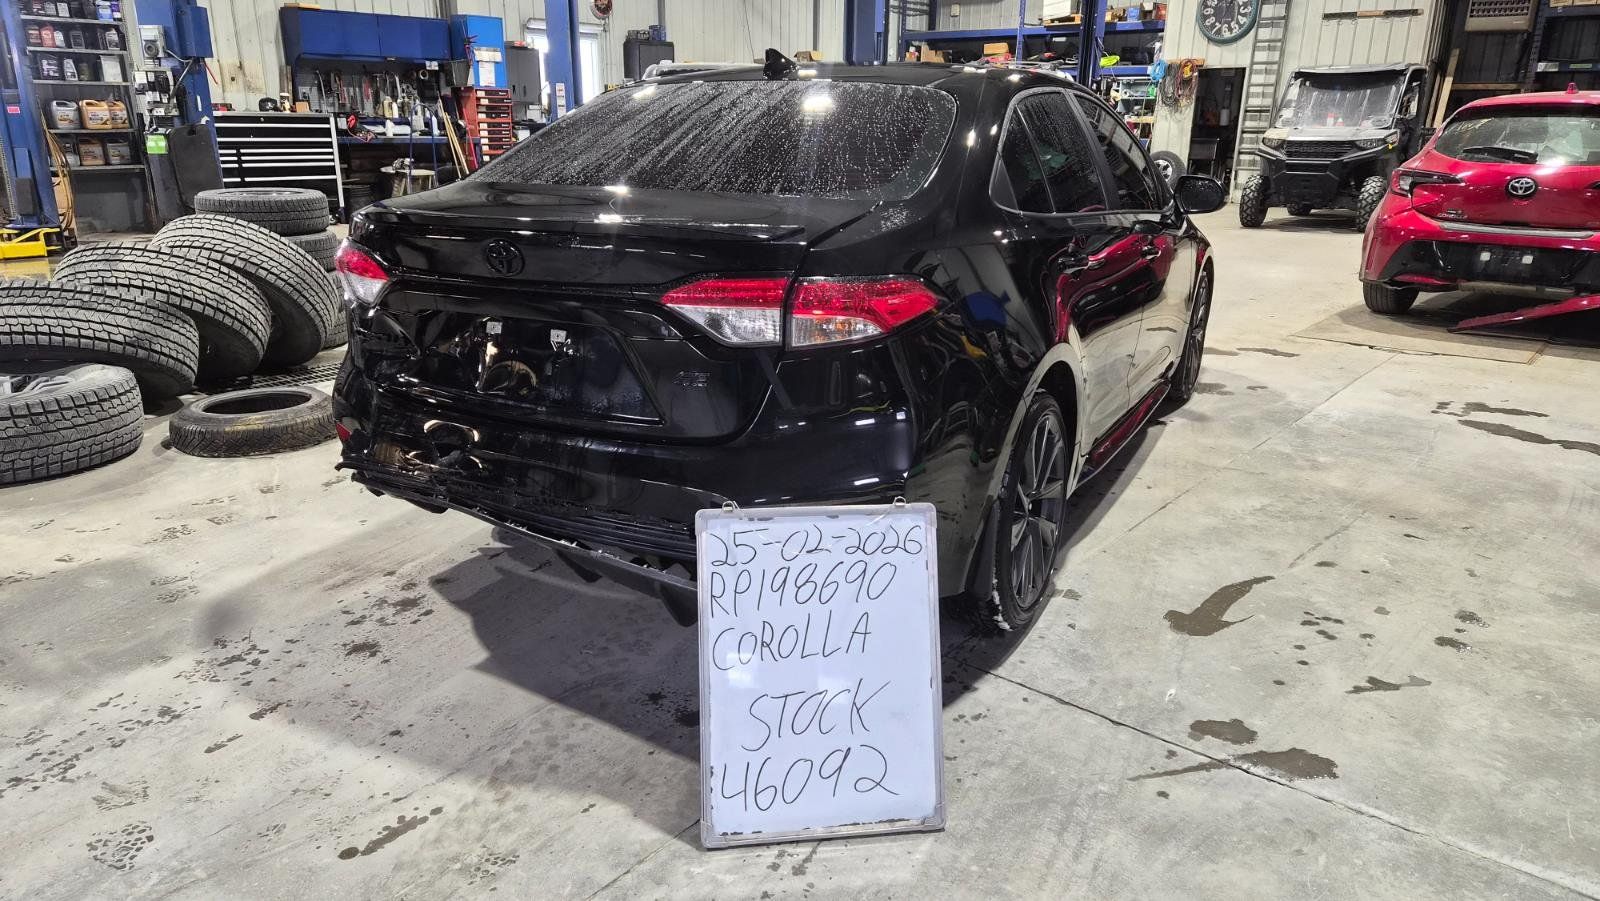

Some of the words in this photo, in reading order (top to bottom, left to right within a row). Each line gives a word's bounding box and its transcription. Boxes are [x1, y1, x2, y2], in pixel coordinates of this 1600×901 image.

[1205, 16, 1216, 25] 8
[1238, 15, 1247, 24] 4
[1211, 22, 1222, 34] 7
[1222, 24, 1229, 34] 6
[1231, 21, 1239, 33] 5
[711, 559, 897, 617] RP198690
[712, 610, 871, 670] COROLLA
[741, 678, 891, 751] STOCK
[721, 744, 899, 811] 46092
